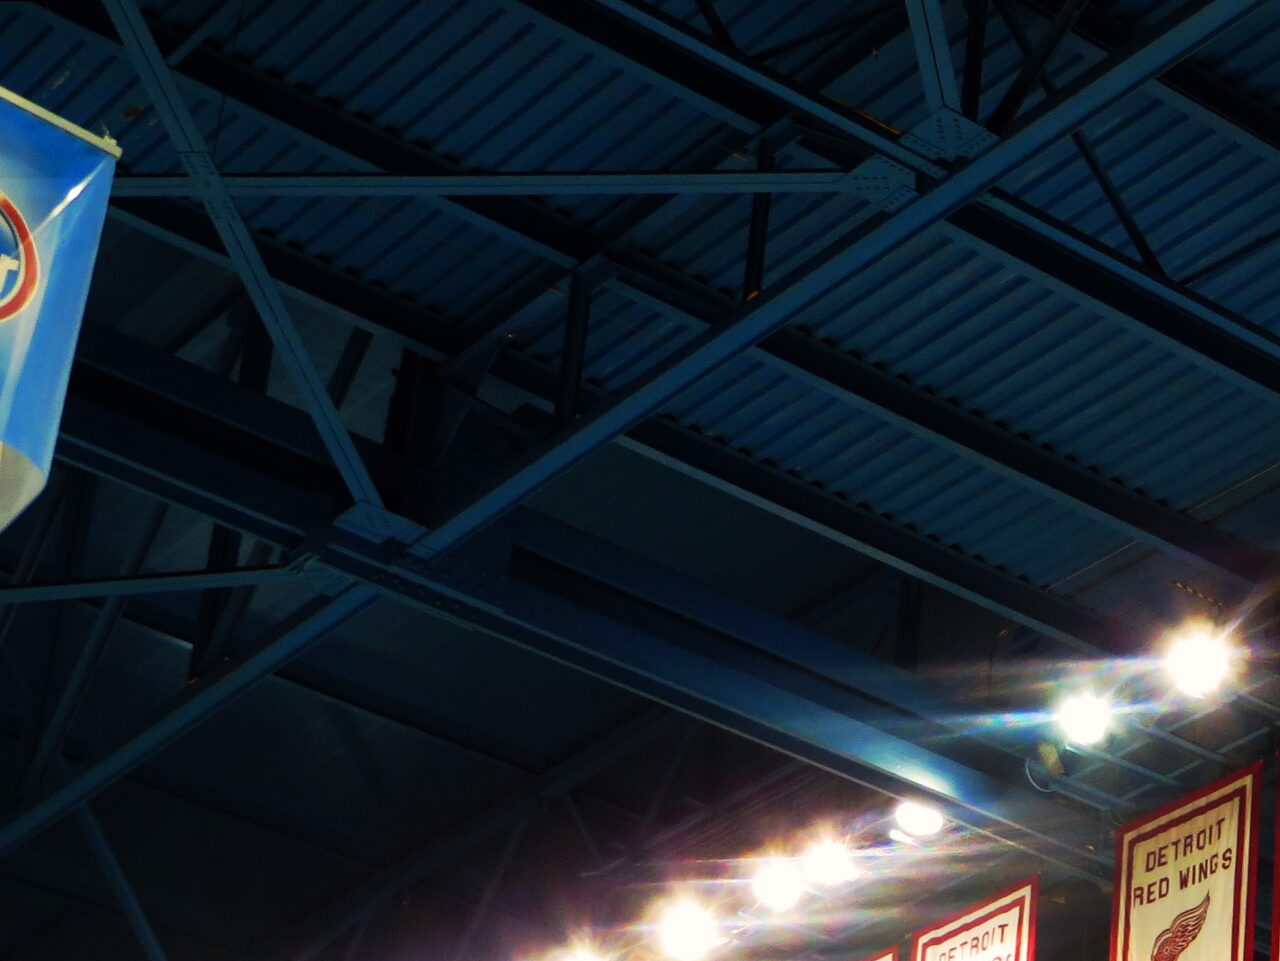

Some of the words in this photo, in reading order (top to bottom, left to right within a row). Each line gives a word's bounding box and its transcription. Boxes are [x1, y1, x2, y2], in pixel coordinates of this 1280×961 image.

[1145, 817, 1226, 873] DETROIT
[1133, 876, 1169, 907] RED
[1179, 847, 1233, 890] WINGS
